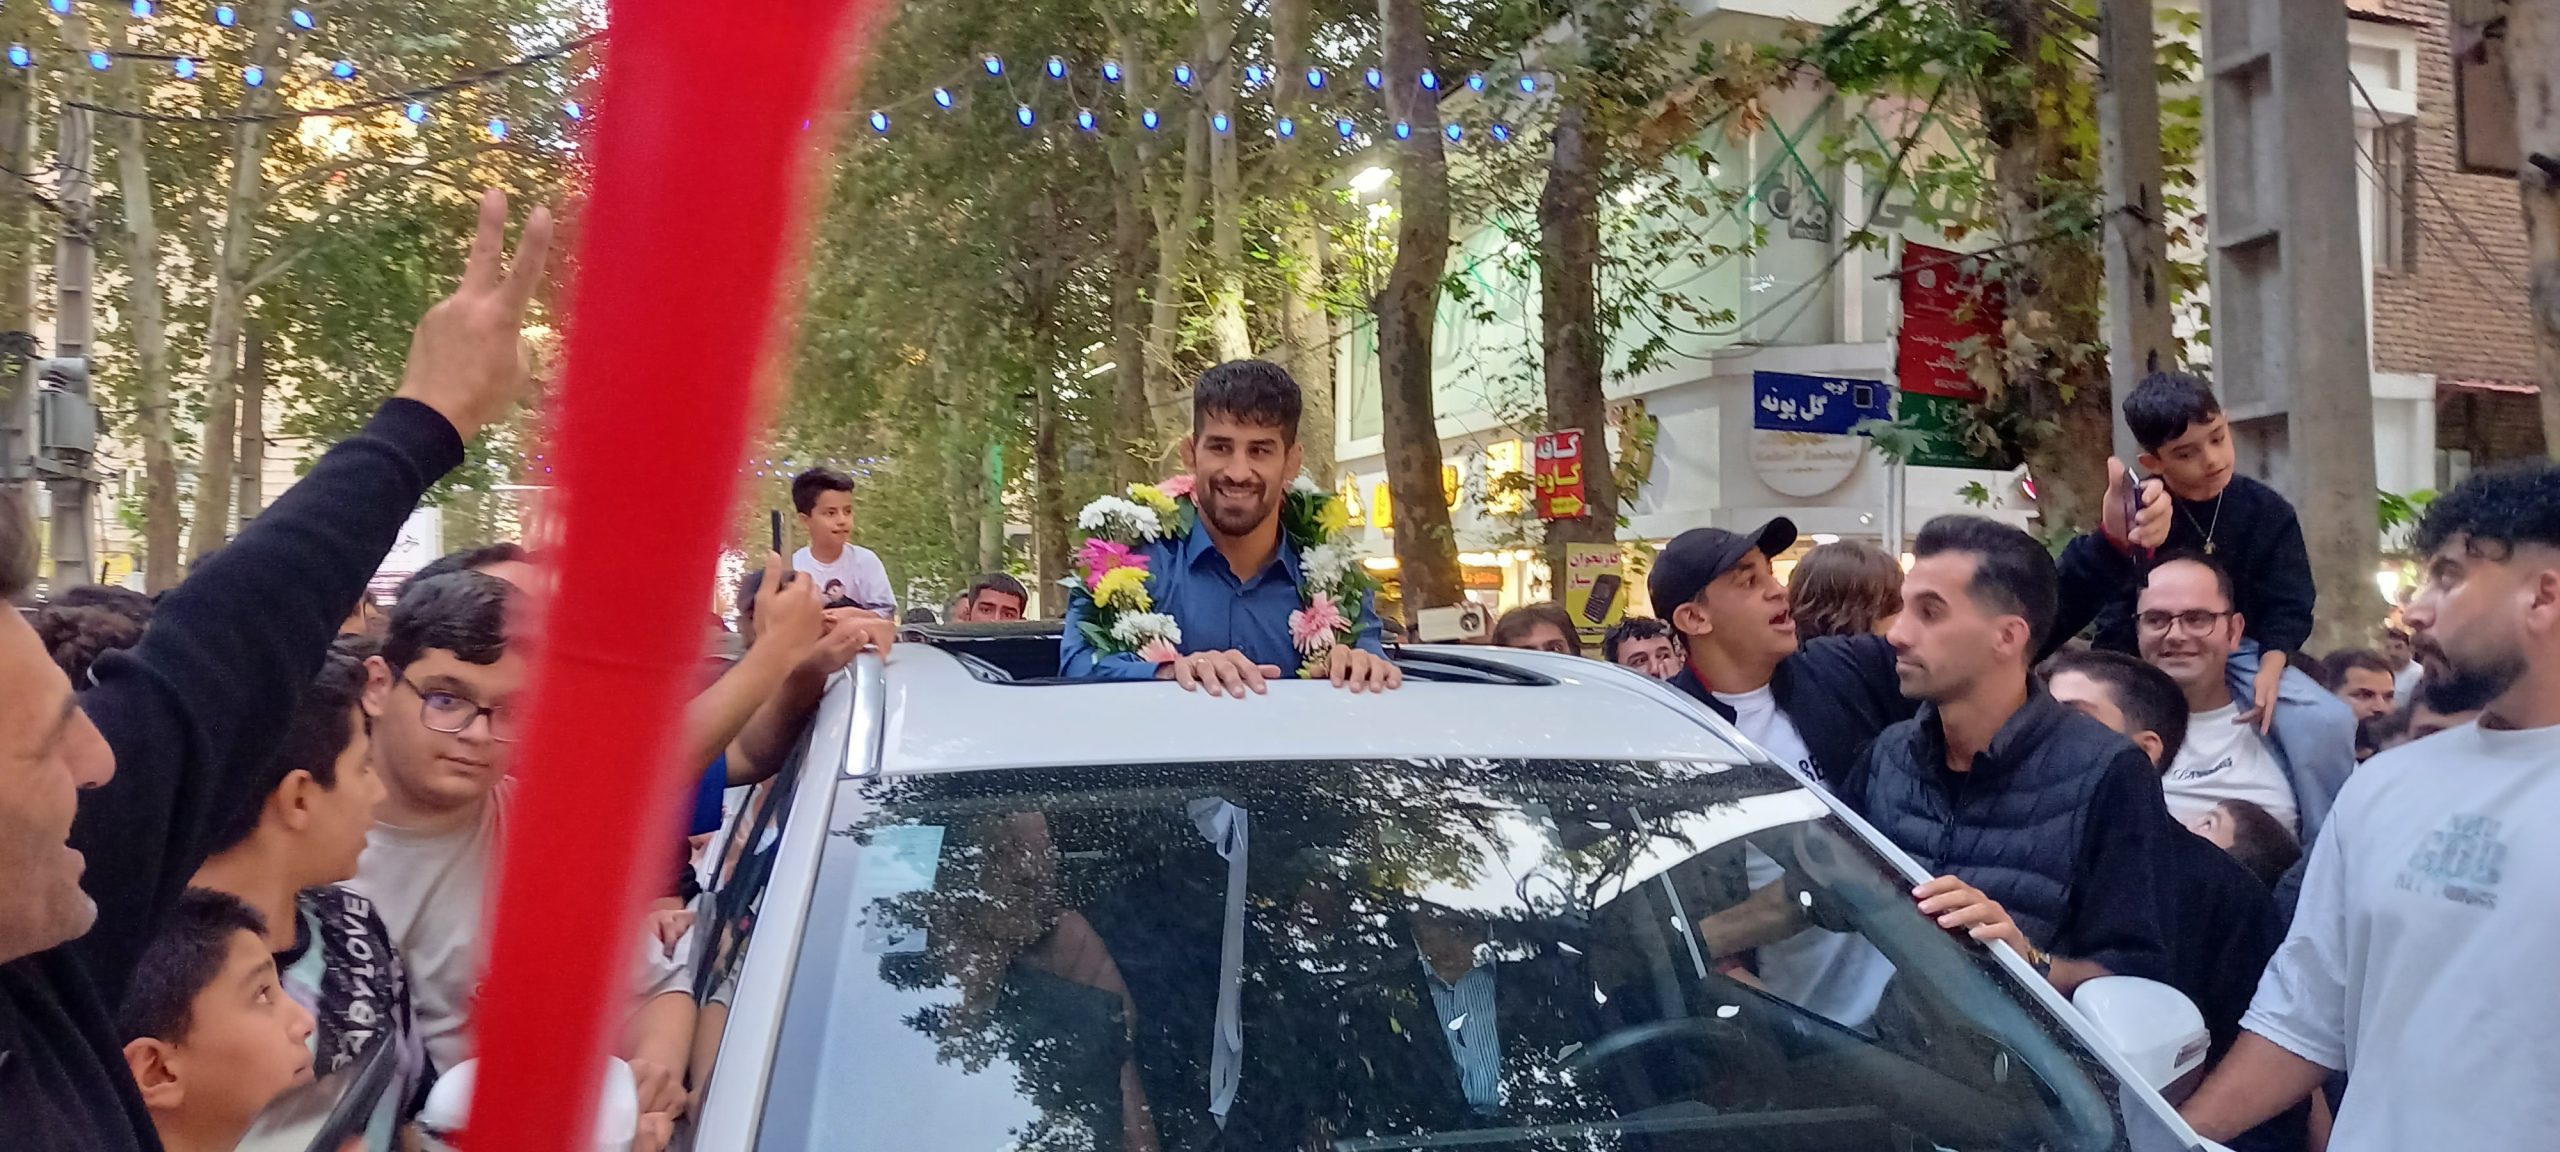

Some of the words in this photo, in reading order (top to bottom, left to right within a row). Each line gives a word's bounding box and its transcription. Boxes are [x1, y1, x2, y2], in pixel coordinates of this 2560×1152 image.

[1760, 386, 1798, 421] پونه
[1800, 394, 1828, 422] گل
[1536, 433, 1580, 460] کافه
